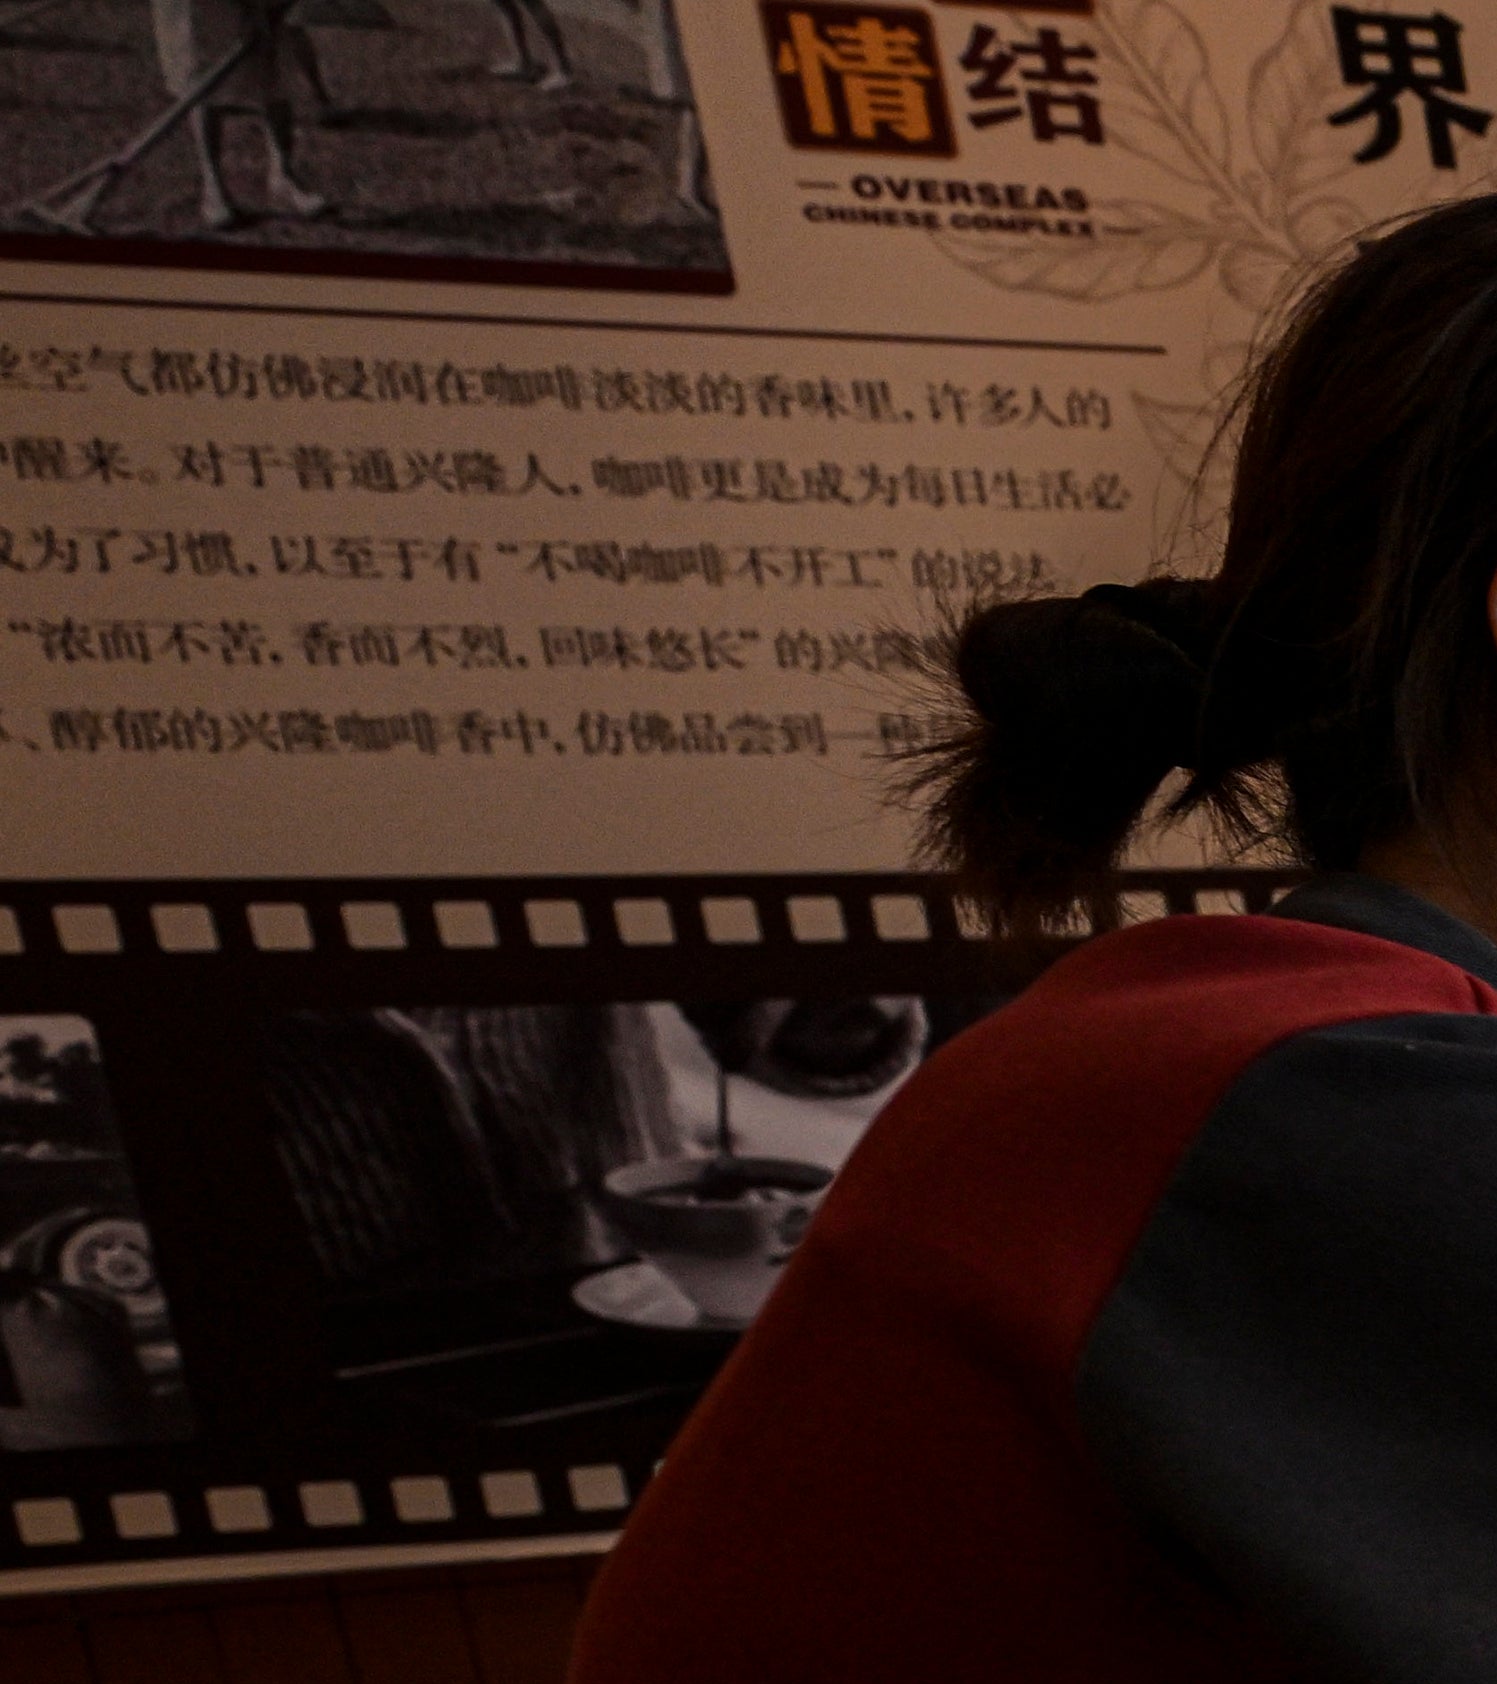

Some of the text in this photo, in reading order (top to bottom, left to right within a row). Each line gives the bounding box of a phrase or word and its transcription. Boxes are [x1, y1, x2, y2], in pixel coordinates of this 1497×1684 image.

[779, 8, 1104, 146] 情结
[803, 203, 1094, 238] CHINESE COMPLEX
[851, 174, 1089, 212] OVERSEAS
[0, 436, 1131, 511] 醒来。对于普通兴隆人，咖啡更是成为每日生活必
